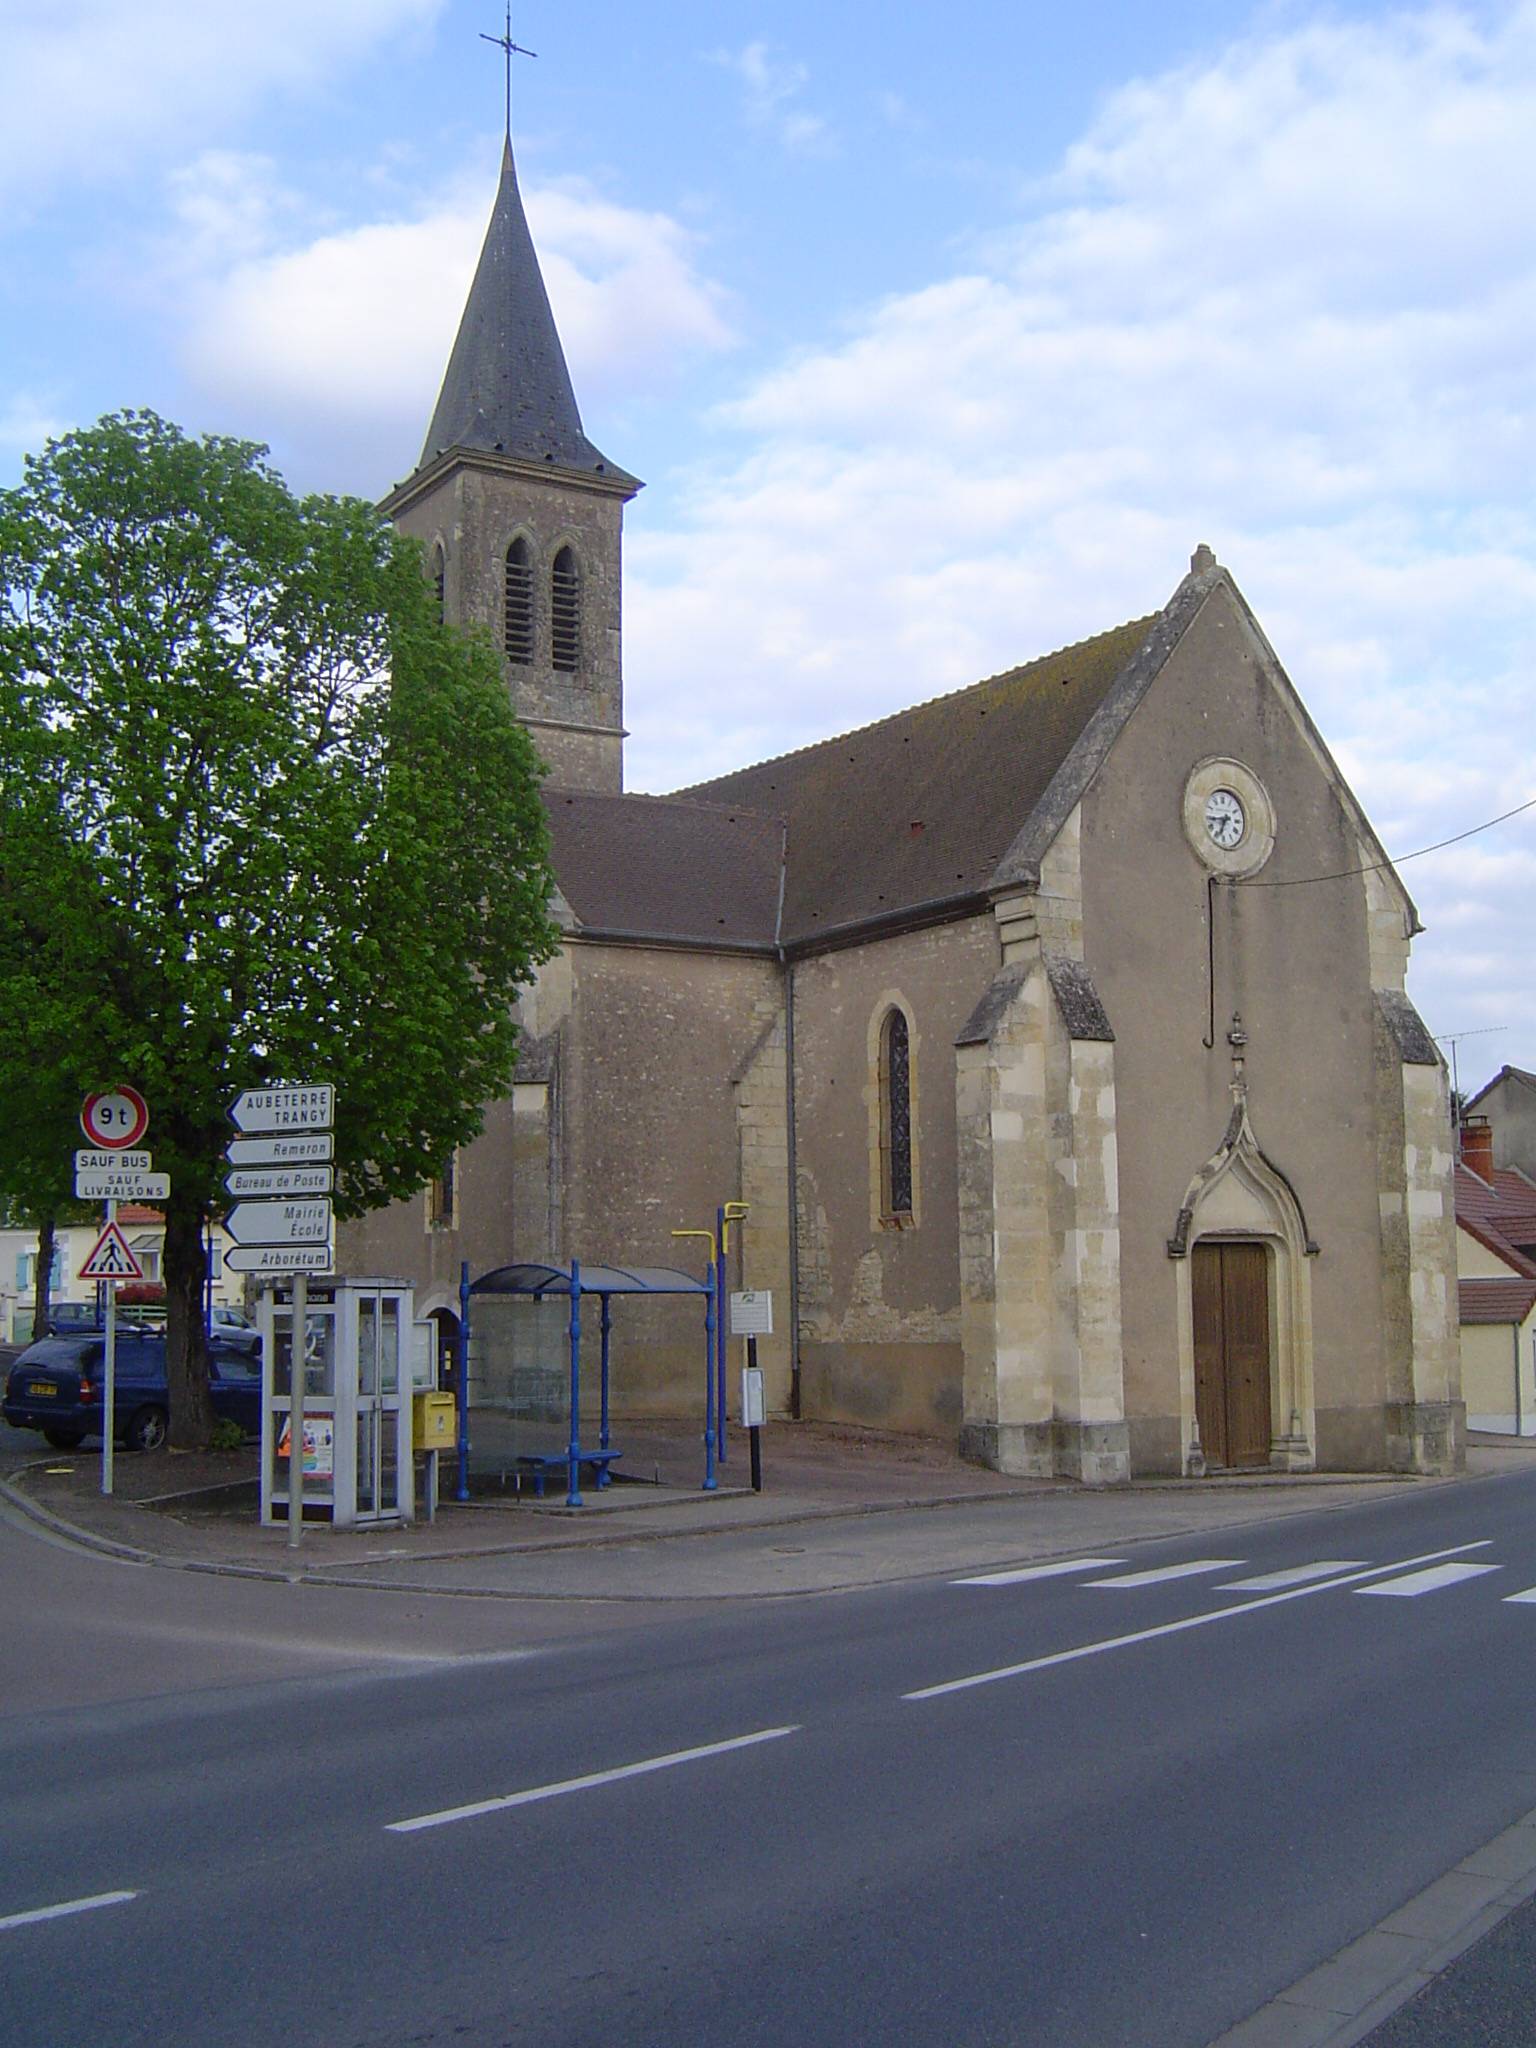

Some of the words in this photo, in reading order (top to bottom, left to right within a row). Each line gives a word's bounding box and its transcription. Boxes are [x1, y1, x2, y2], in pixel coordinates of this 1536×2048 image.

[247, 1091, 327, 1109] AUBETERRE
[101, 1108, 112, 1125] 9
[119, 1108, 128, 1125] t
[274, 1109, 326, 1124] TRANGY
[273, 1142, 326, 1156] Remeron
[80, 1155, 116, 1168] SAUF
[121, 1155, 148, 1168] BUS
[107, 1175, 142, 1185] SAUF
[235, 1176, 272, 1189] Bureau
[276, 1174, 290, 1187] de
[293, 1173, 325, 1186] Poste
[84, 1186, 163, 1196] LIVRAISONS
[283, 1206, 324, 1220] Mairie
[290, 1221, 324, 1237] École
[260, 1251, 325, 1265] Arborétum
